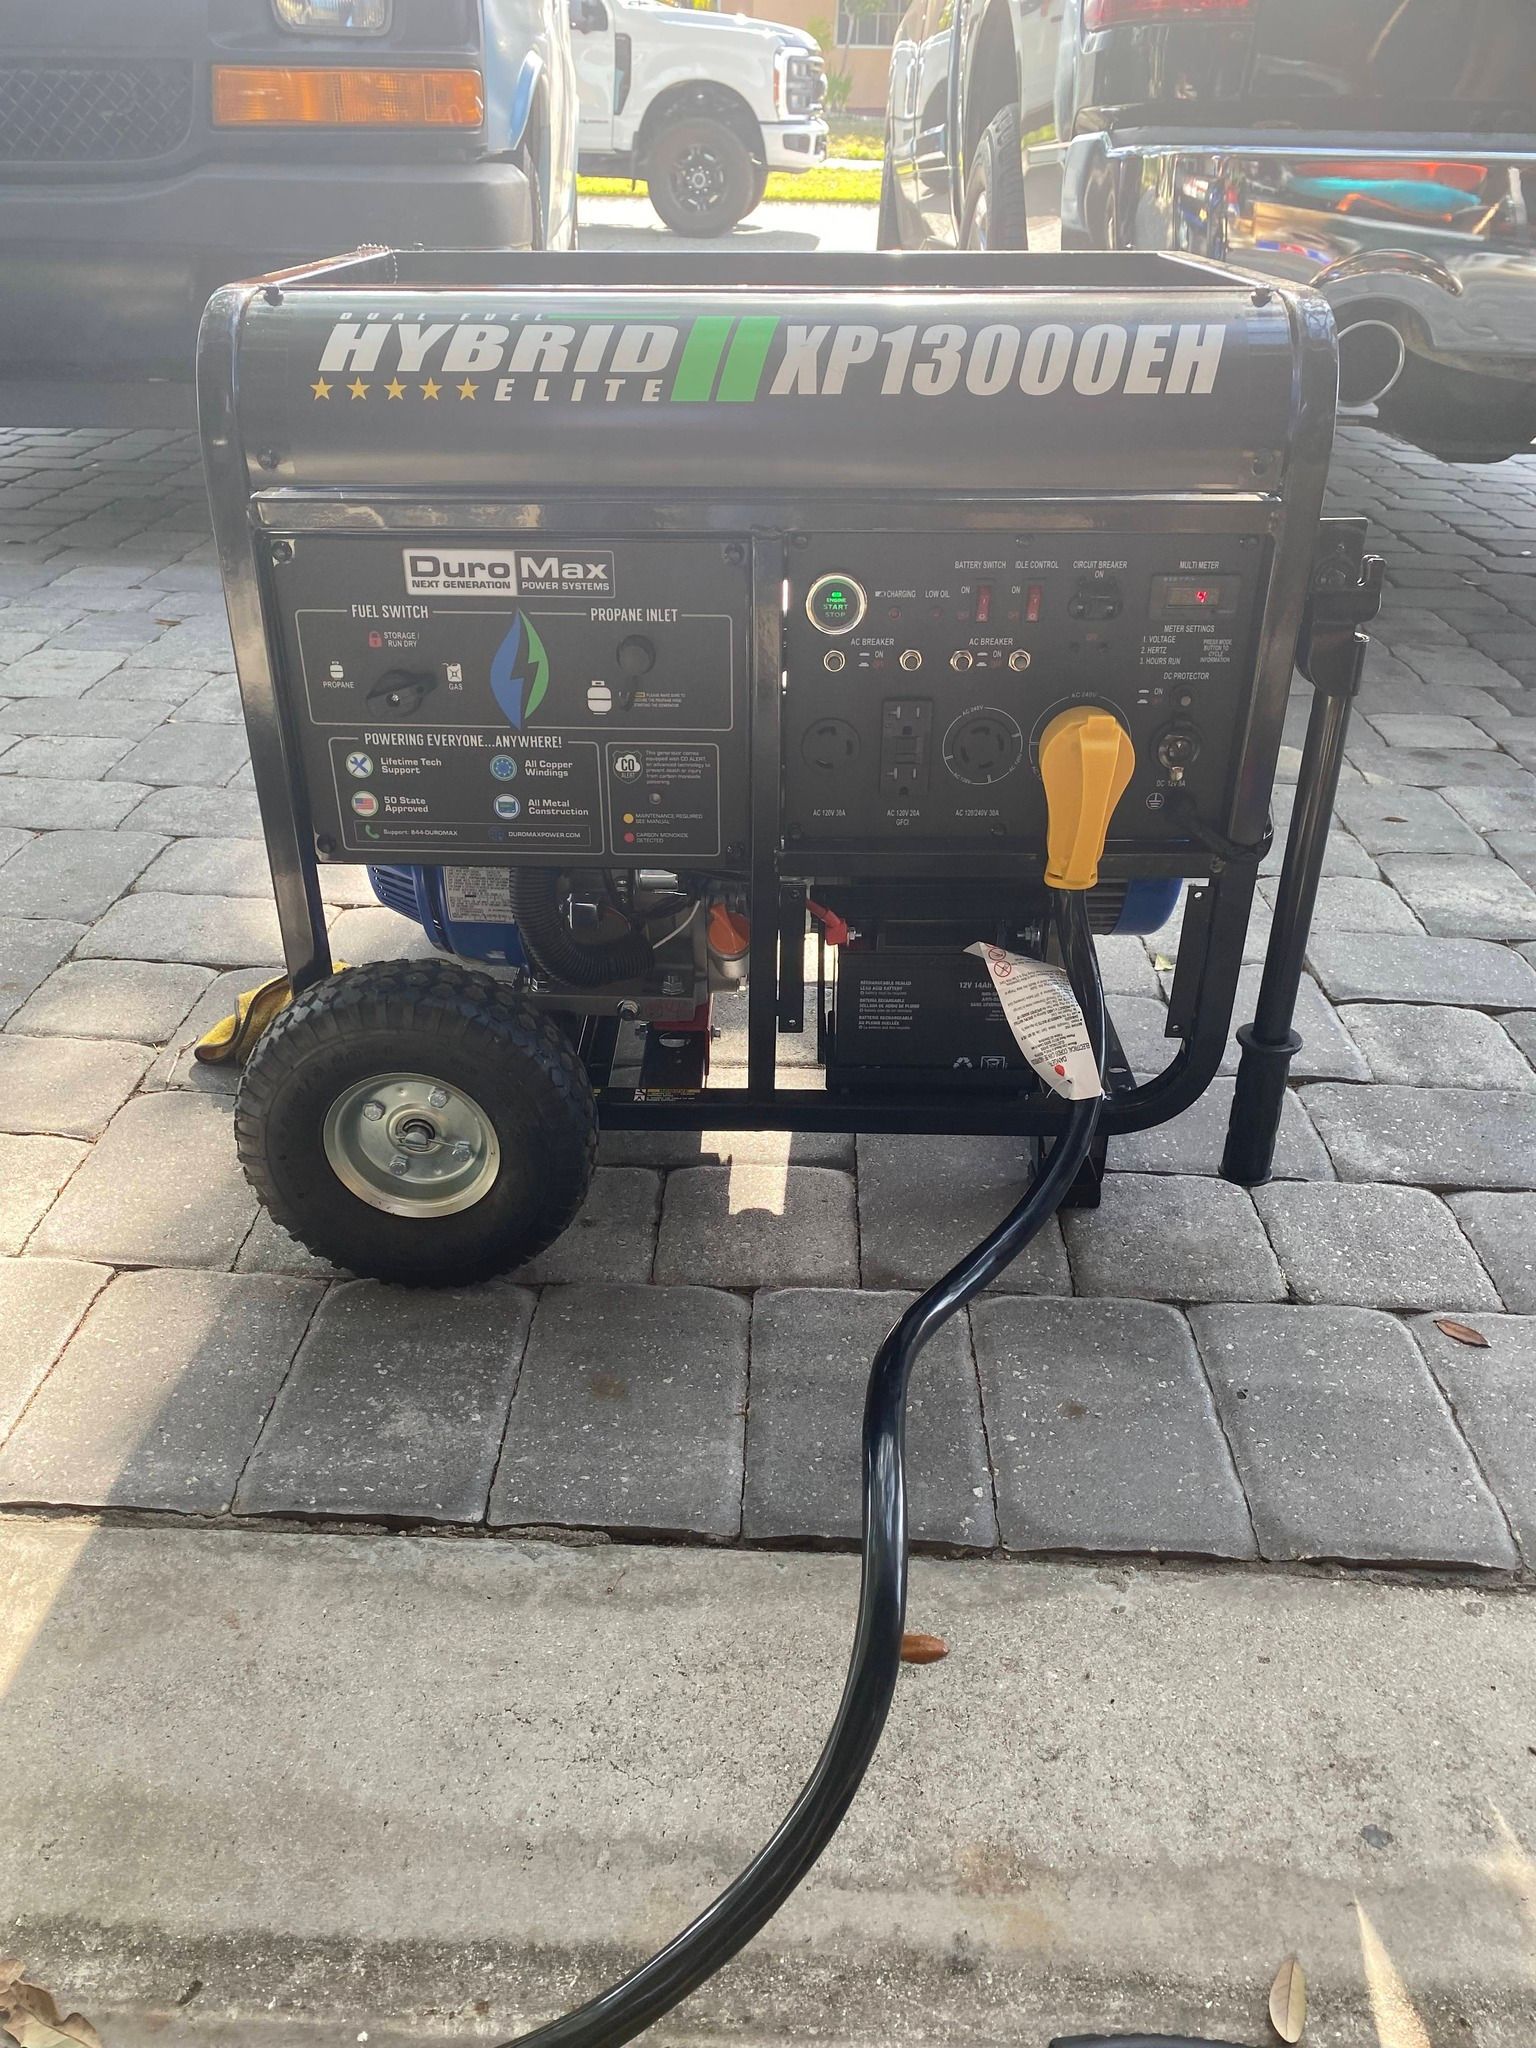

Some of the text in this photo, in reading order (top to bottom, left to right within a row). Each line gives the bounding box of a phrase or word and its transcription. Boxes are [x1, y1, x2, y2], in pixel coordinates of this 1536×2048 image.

[340, 312, 546, 321] DUAL FUEL
[318, 323, 679, 373] HYBRID
[769, 323, 1226, 396] XP13000EH
[494, 378, 663, 402] ELITE
[954, 561, 1007, 569] BATTERY SWITCH
[1015, 561, 1059, 569] IDLE CONTROL
[1073, 561, 1128, 569] CIRCUIT BREAKER
[1179, 561, 1220, 569] MULTI METER
[1094, 570, 1104, 578] ON
[411, 579, 609, 591] NEXT GENERATION POWER SYSTEMS
[886, 590, 916, 598] CHARGING
[925, 590, 950, 598] LOW OIL
[961, 586, 971, 594] ON
[1011, 586, 1021, 594] ON
[351, 604, 429, 619] FUEL SWITCH
[590, 608, 678, 622] PROPANE INLET
[1164, 625, 1215, 633] METER SETTINGS
[383, 632, 416, 640] STORAGE
[388, 640, 417, 648] RUN DRY
[850, 638, 895, 646] AC BREAKER
[969, 638, 1013, 646] AC BREAKER
[875, 650, 884, 658] ON
[992, 650, 1002, 658] ON
[1146, 657, 1167, 665] HOURS
[1168, 657, 1181, 665] RUN
[1164, 672, 1209, 680] DC PROTECTOR
[323, 681, 355, 689] PROPANE
[448, 683, 463, 691] GAS
[364, 732, 563, 748] POWERING EVERYONE...ANYWHERE!
[380, 757, 442, 767] Lifetime Tech
[524, 760, 573, 771] All Copper
[621, 758, 635, 771] CO
[381, 766, 421, 776] Support
[525, 768, 569, 779] Windings
[384, 796, 426, 805] 50 State
[528, 799, 570, 807] All Metal
[385, 804, 429, 814] Approved
[528, 807, 589, 816] Construction
[813, 809, 822, 817] AC
[887, 809, 896, 817] AC
[955, 809, 964, 817] AC
[959, 981, 973, 989] 12V
